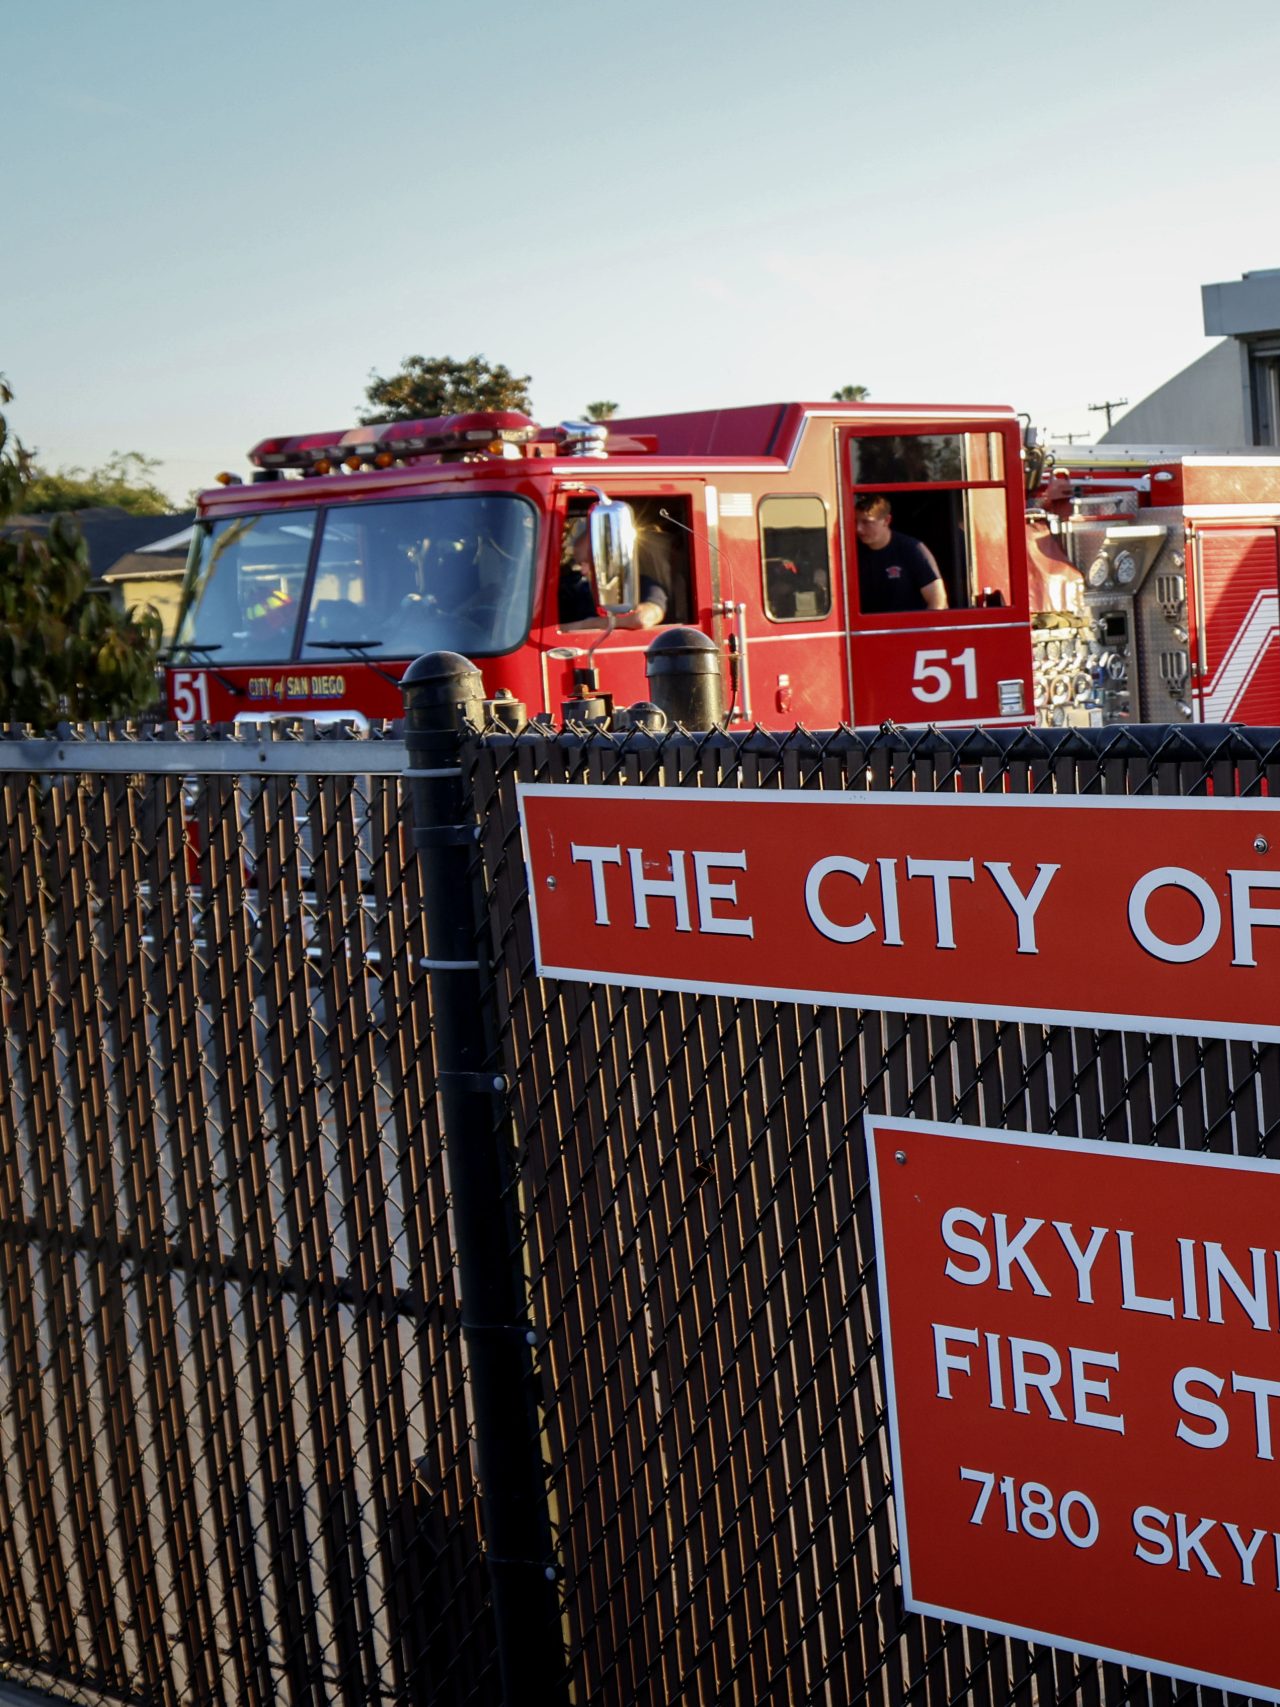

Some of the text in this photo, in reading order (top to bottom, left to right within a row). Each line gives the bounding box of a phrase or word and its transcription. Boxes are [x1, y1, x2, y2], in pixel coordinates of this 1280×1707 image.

[174, 672, 210, 722] 51
[249, 675, 344, 701] CITY of SAN DIEGO
[910, 647, 978, 703] 51
[571, 842, 753, 938] THE
[806, 856, 1061, 953] CITY
[932, 1323, 1126, 1436] FIRE
[960, 1466, 1100, 1549] 7180
